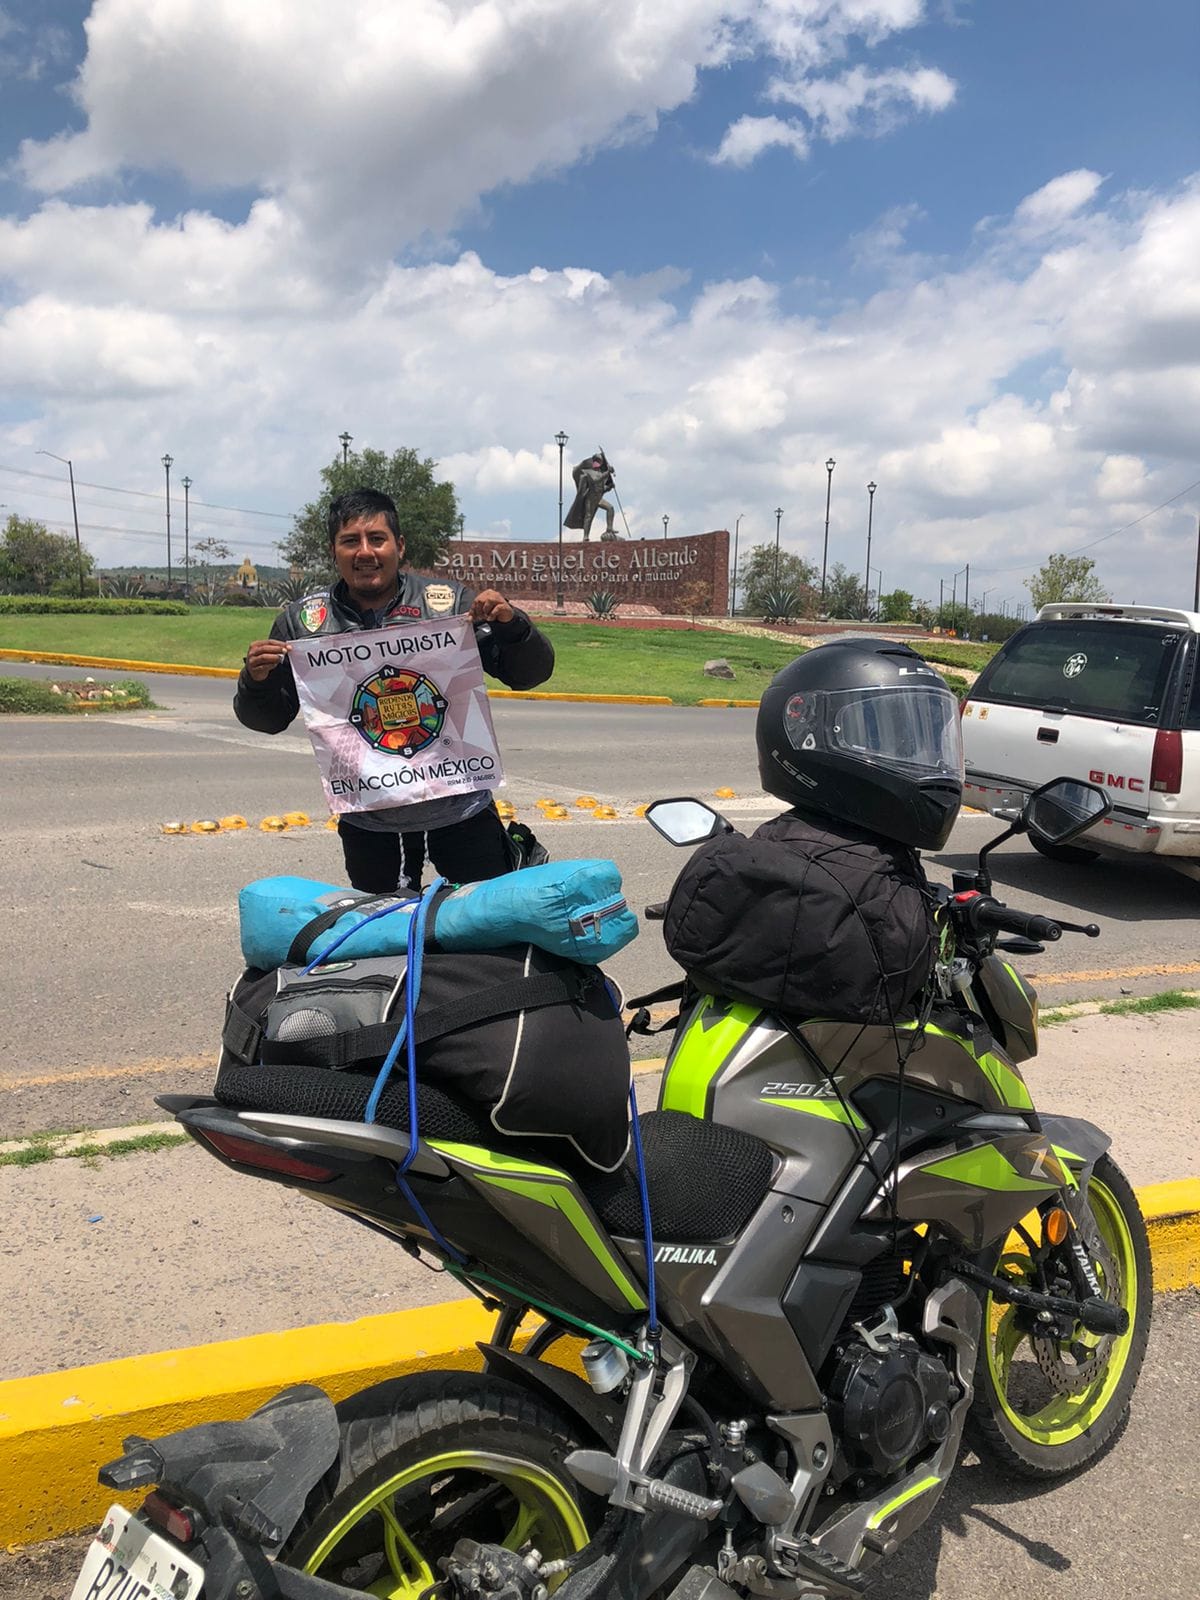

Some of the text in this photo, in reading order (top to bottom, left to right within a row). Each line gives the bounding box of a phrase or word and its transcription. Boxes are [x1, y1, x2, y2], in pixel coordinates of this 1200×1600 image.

[434, 544, 698, 571] San Miguel de Allende
[479, 570, 526, 582] regalo
[531, 571, 548, 582] de
[601, 571, 628, 582] Para
[632, 570, 642, 582] el
[307, 631, 457, 668] MOTO TURISTA
[384, 668, 395, 676] N
[331, 756, 494, 795] EN ACCIÓN MÉXICO
[771, 750, 819, 789] LS2
[1089, 770, 1145, 793] GMC
[654, 1247, 717, 1265] ITALIKA
[1072, 1244, 1101, 1299] ITALIKA
